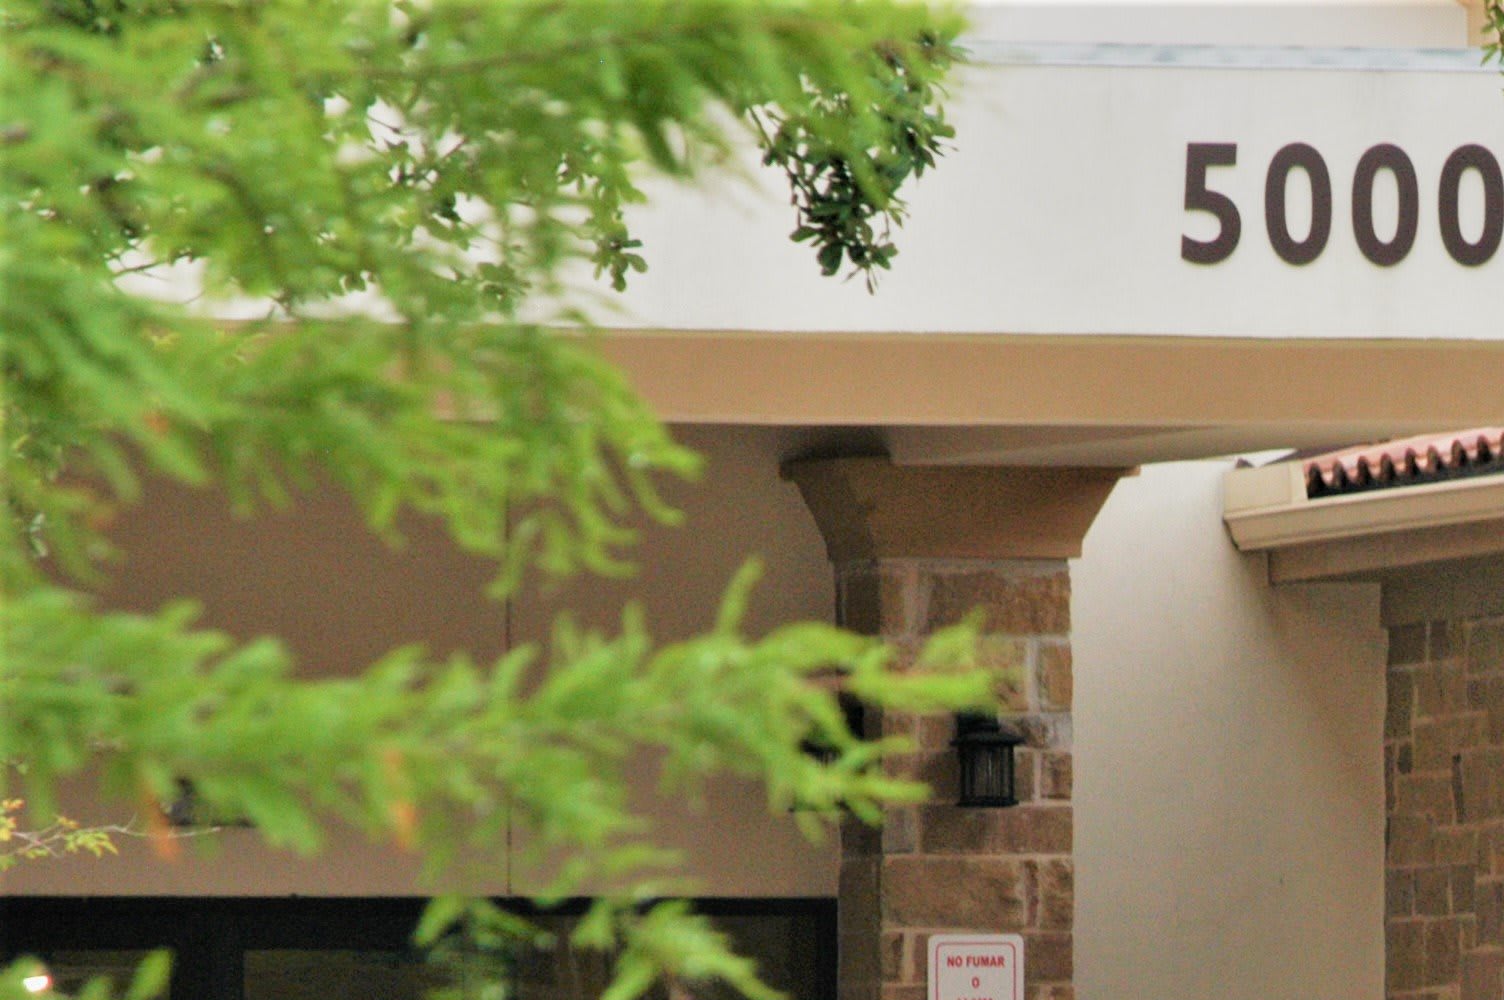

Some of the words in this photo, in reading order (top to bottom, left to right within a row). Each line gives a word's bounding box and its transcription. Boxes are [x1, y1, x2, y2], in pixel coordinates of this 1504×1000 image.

[1181, 142, 1504, 267] 5000
[947, 956, 963, 967] NO
[966, 956, 1005, 967] FUMAR
[971, 976, 980, 989] O
